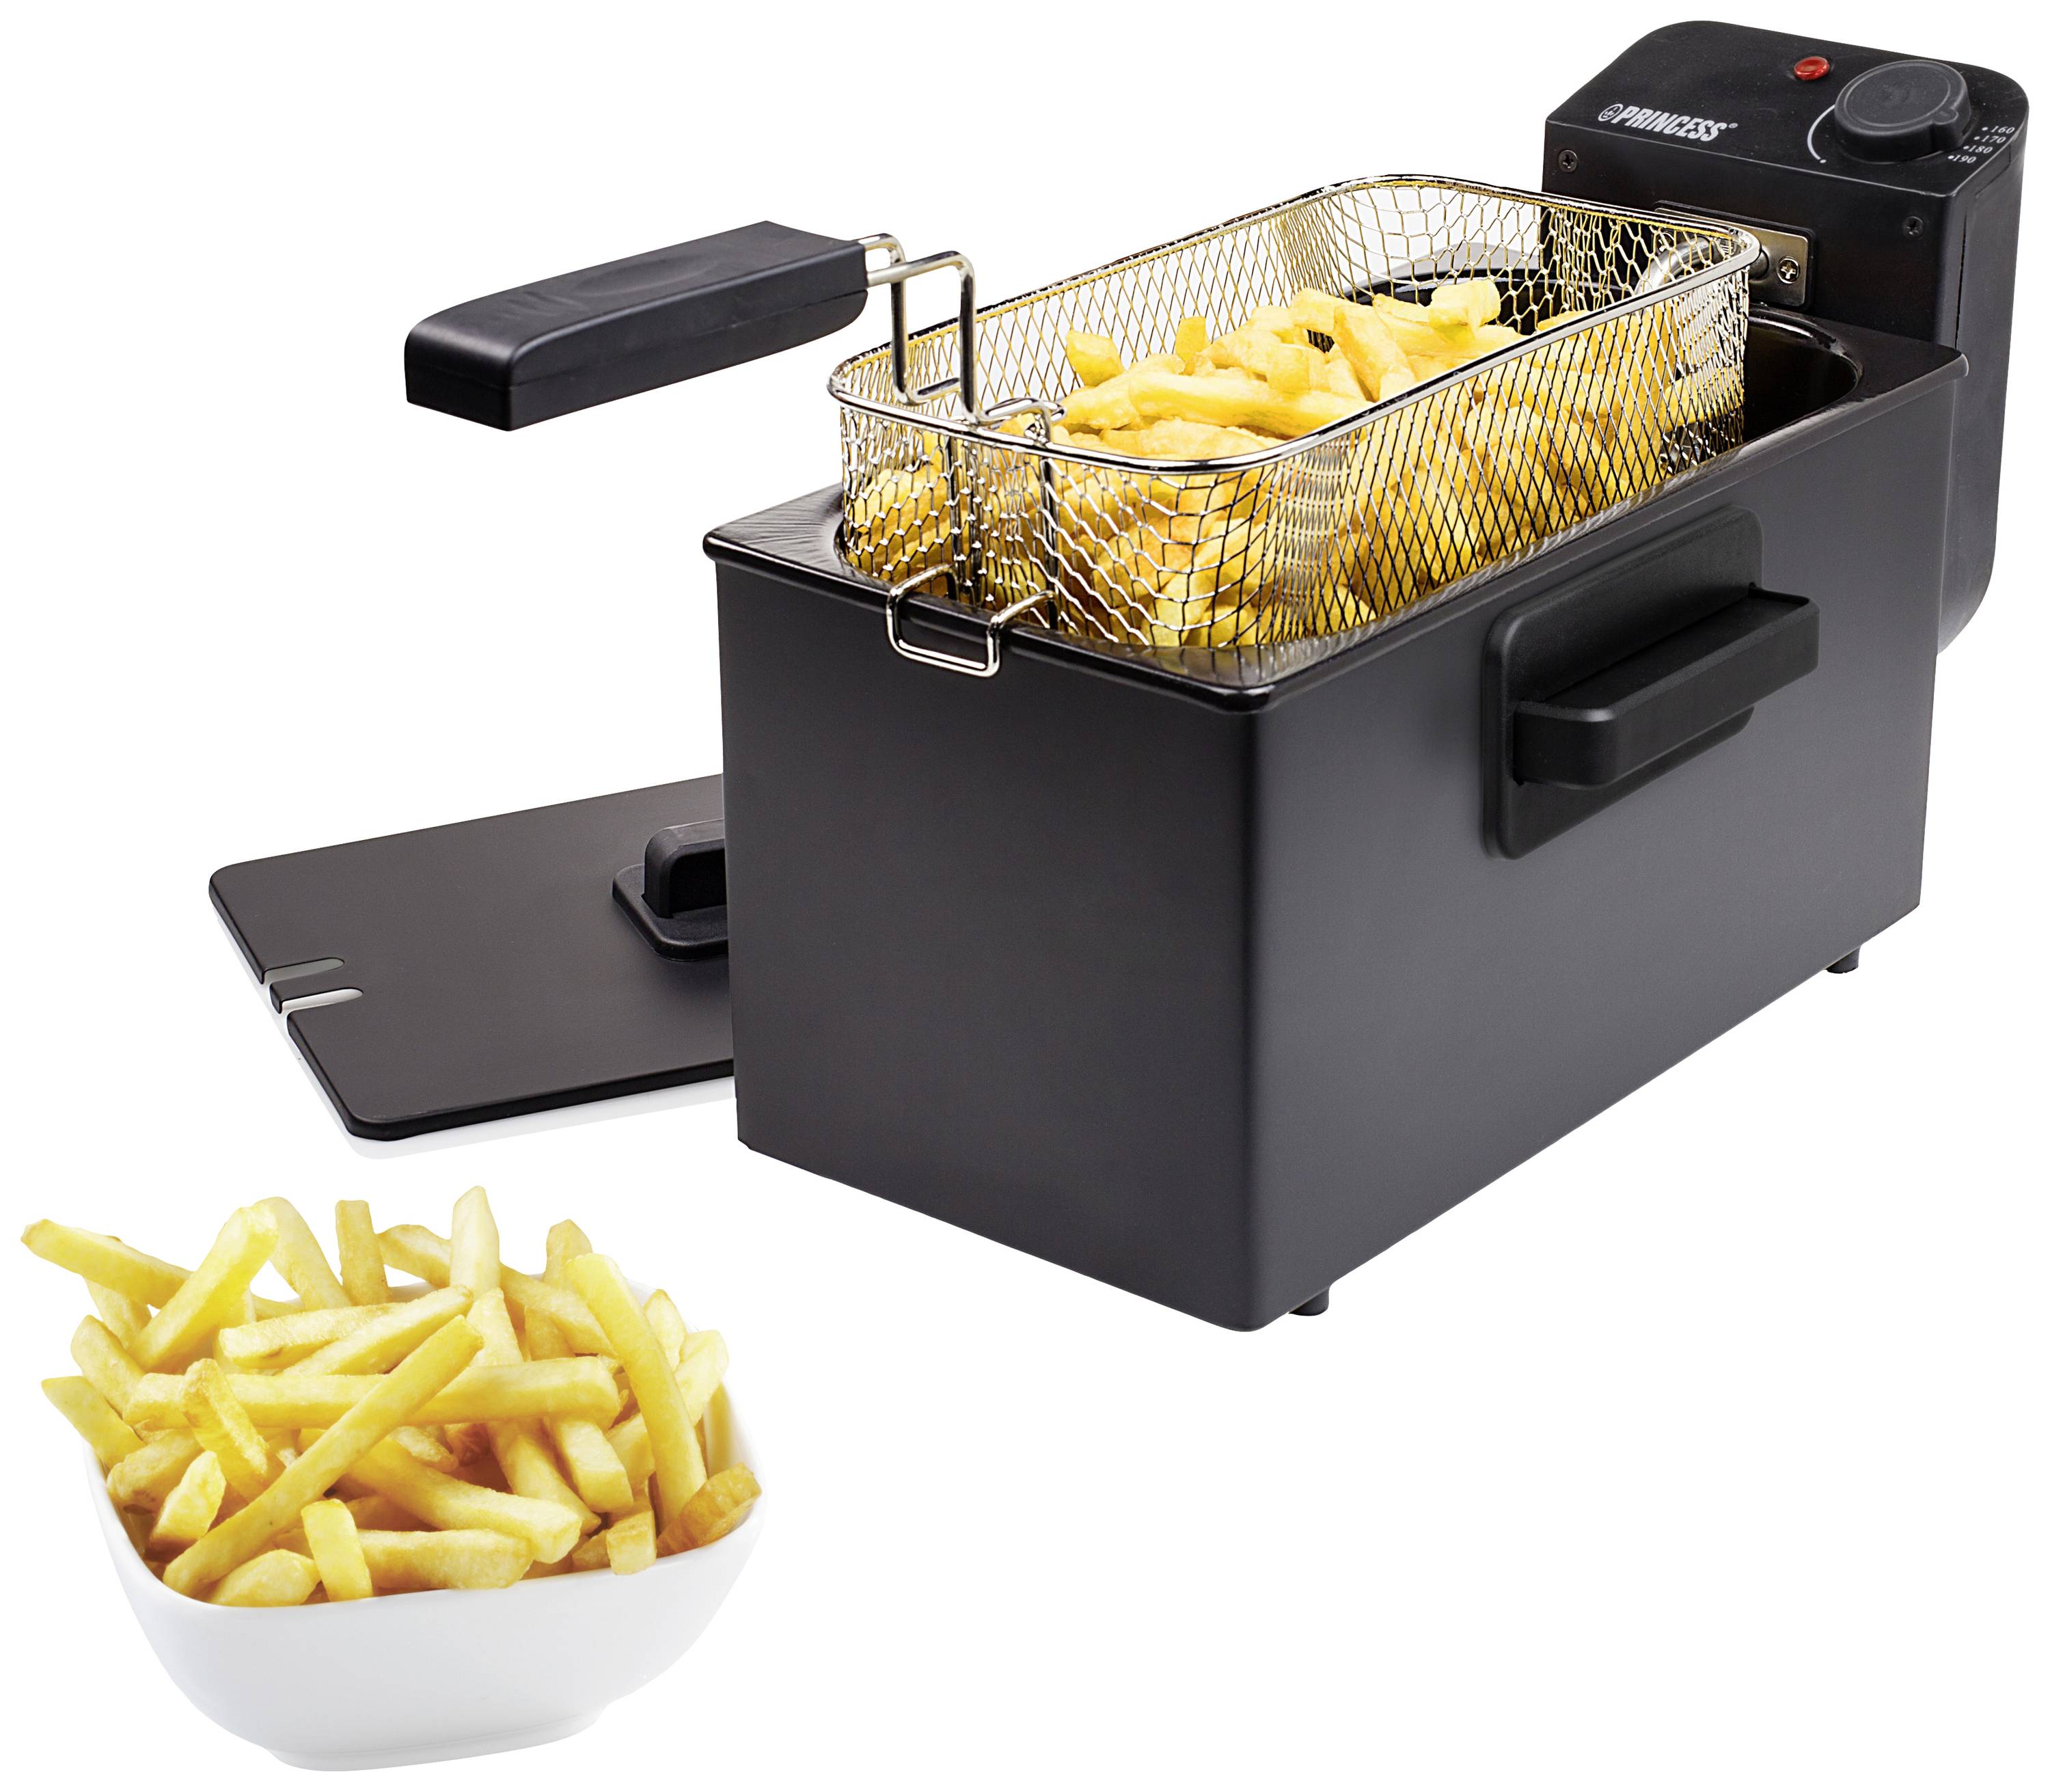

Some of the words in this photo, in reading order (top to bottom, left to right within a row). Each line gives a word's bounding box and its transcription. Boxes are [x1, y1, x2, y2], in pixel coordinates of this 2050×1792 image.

[1611, 105, 1727, 141] PRINCESS
[1991, 126, 2015, 134] 160
[1982, 135, 2006, 144] 170
[1968, 145, 1993, 154] 180
[1952, 154, 1977, 163] 190
